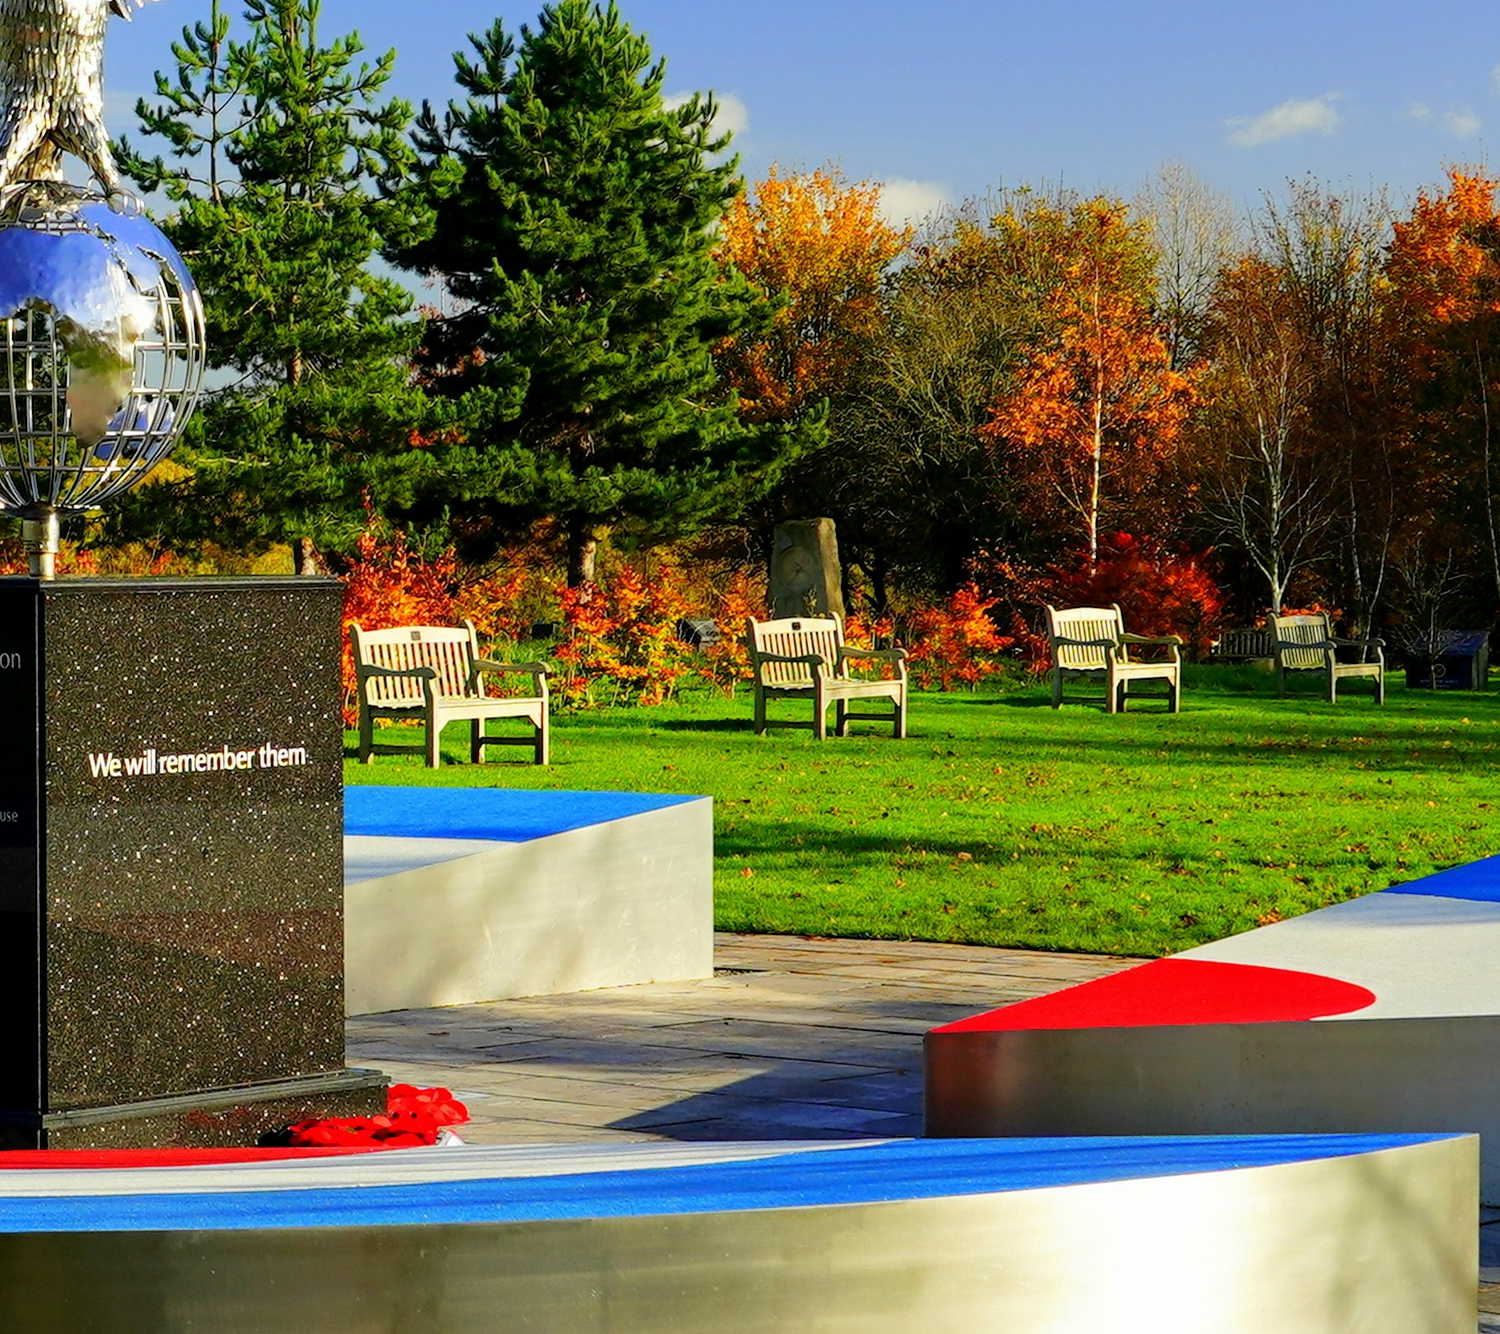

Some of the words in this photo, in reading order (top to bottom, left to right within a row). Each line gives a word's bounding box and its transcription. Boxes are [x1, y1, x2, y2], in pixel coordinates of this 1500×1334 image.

[89, 752, 121, 777] We
[124, 749, 156, 776] will
[158, 745, 255, 774] remember
[258, 742, 306, 768] them
